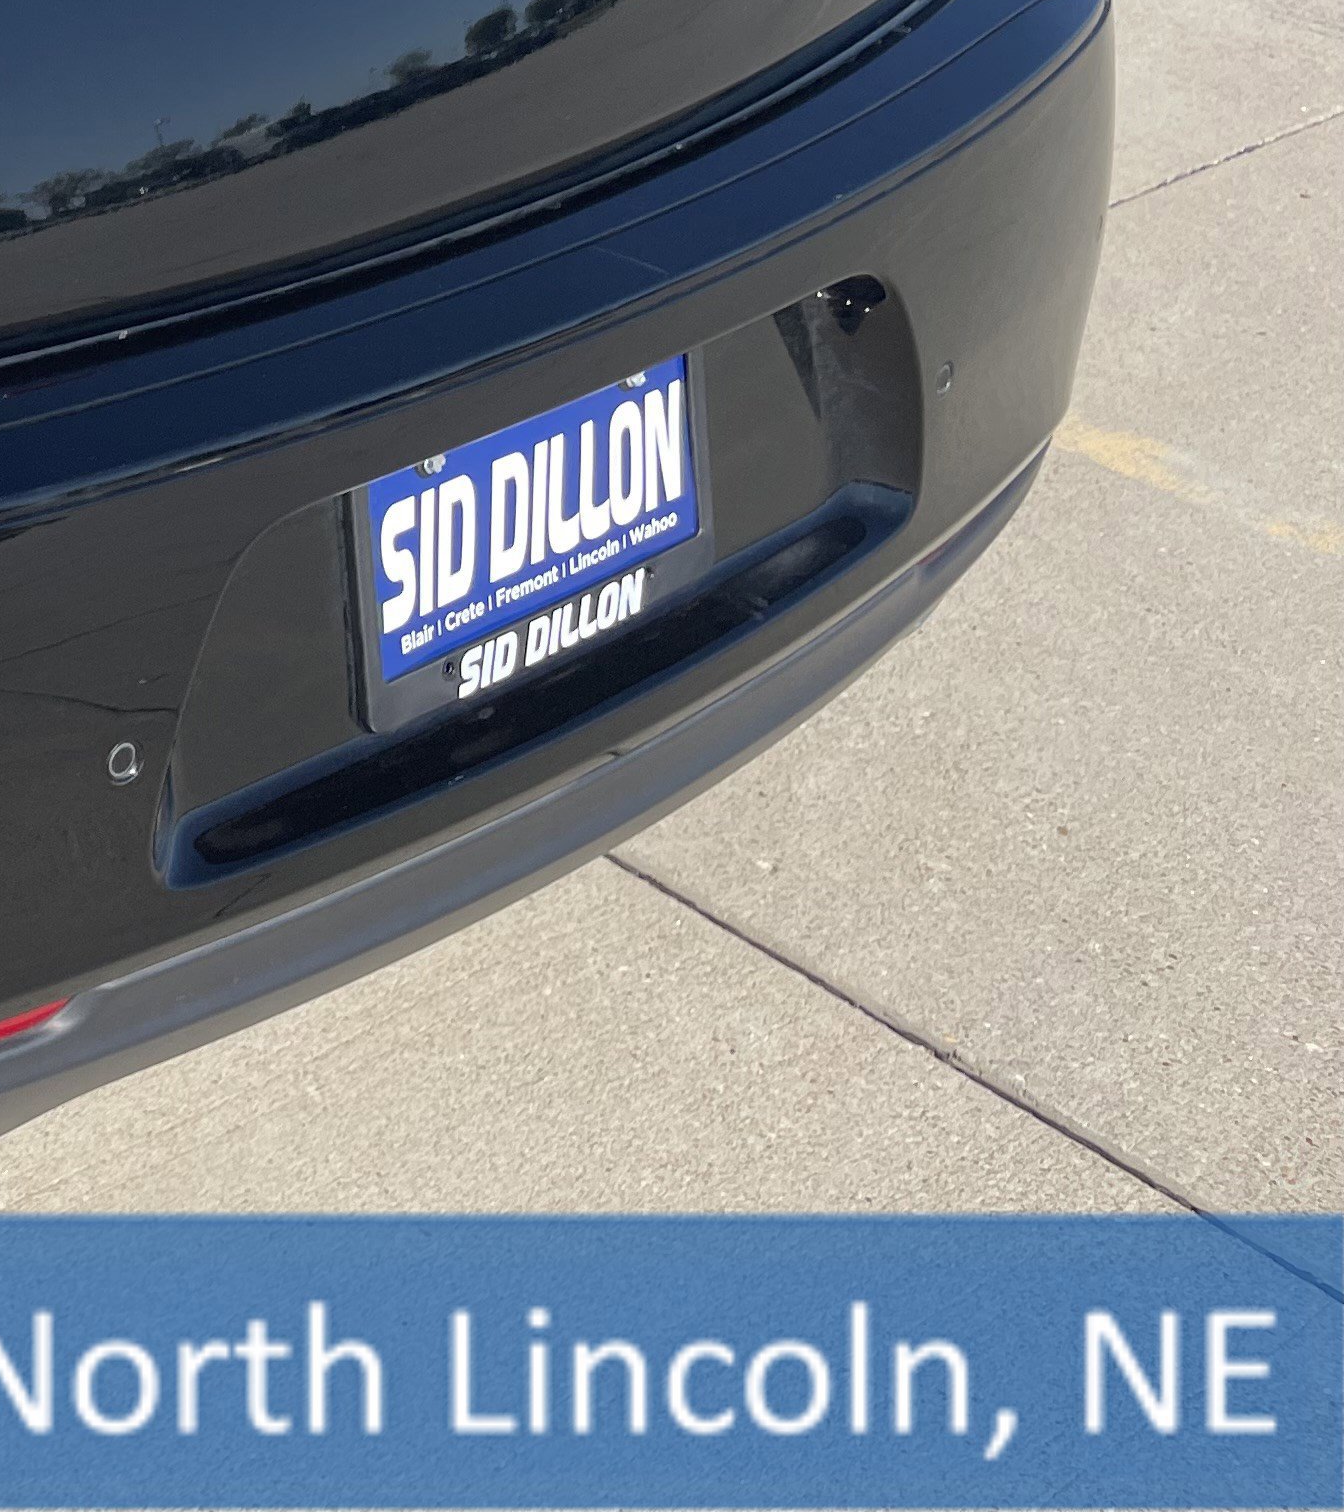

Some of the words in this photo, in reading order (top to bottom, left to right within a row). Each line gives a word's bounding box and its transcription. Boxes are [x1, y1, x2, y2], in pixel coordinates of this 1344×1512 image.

[380, 473, 477, 635] SID
[489, 378, 683, 585] DILLON
[400, 622, 436, 655] Blair
[443, 600, 487, 632] Crete
[494, 565, 560, 609] Fremont
[568, 537, 621, 575] Lincoln
[628, 511, 679, 547] Wahoo
[458, 630, 519, 700] SID
[524, 566, 647, 668] DILLON
